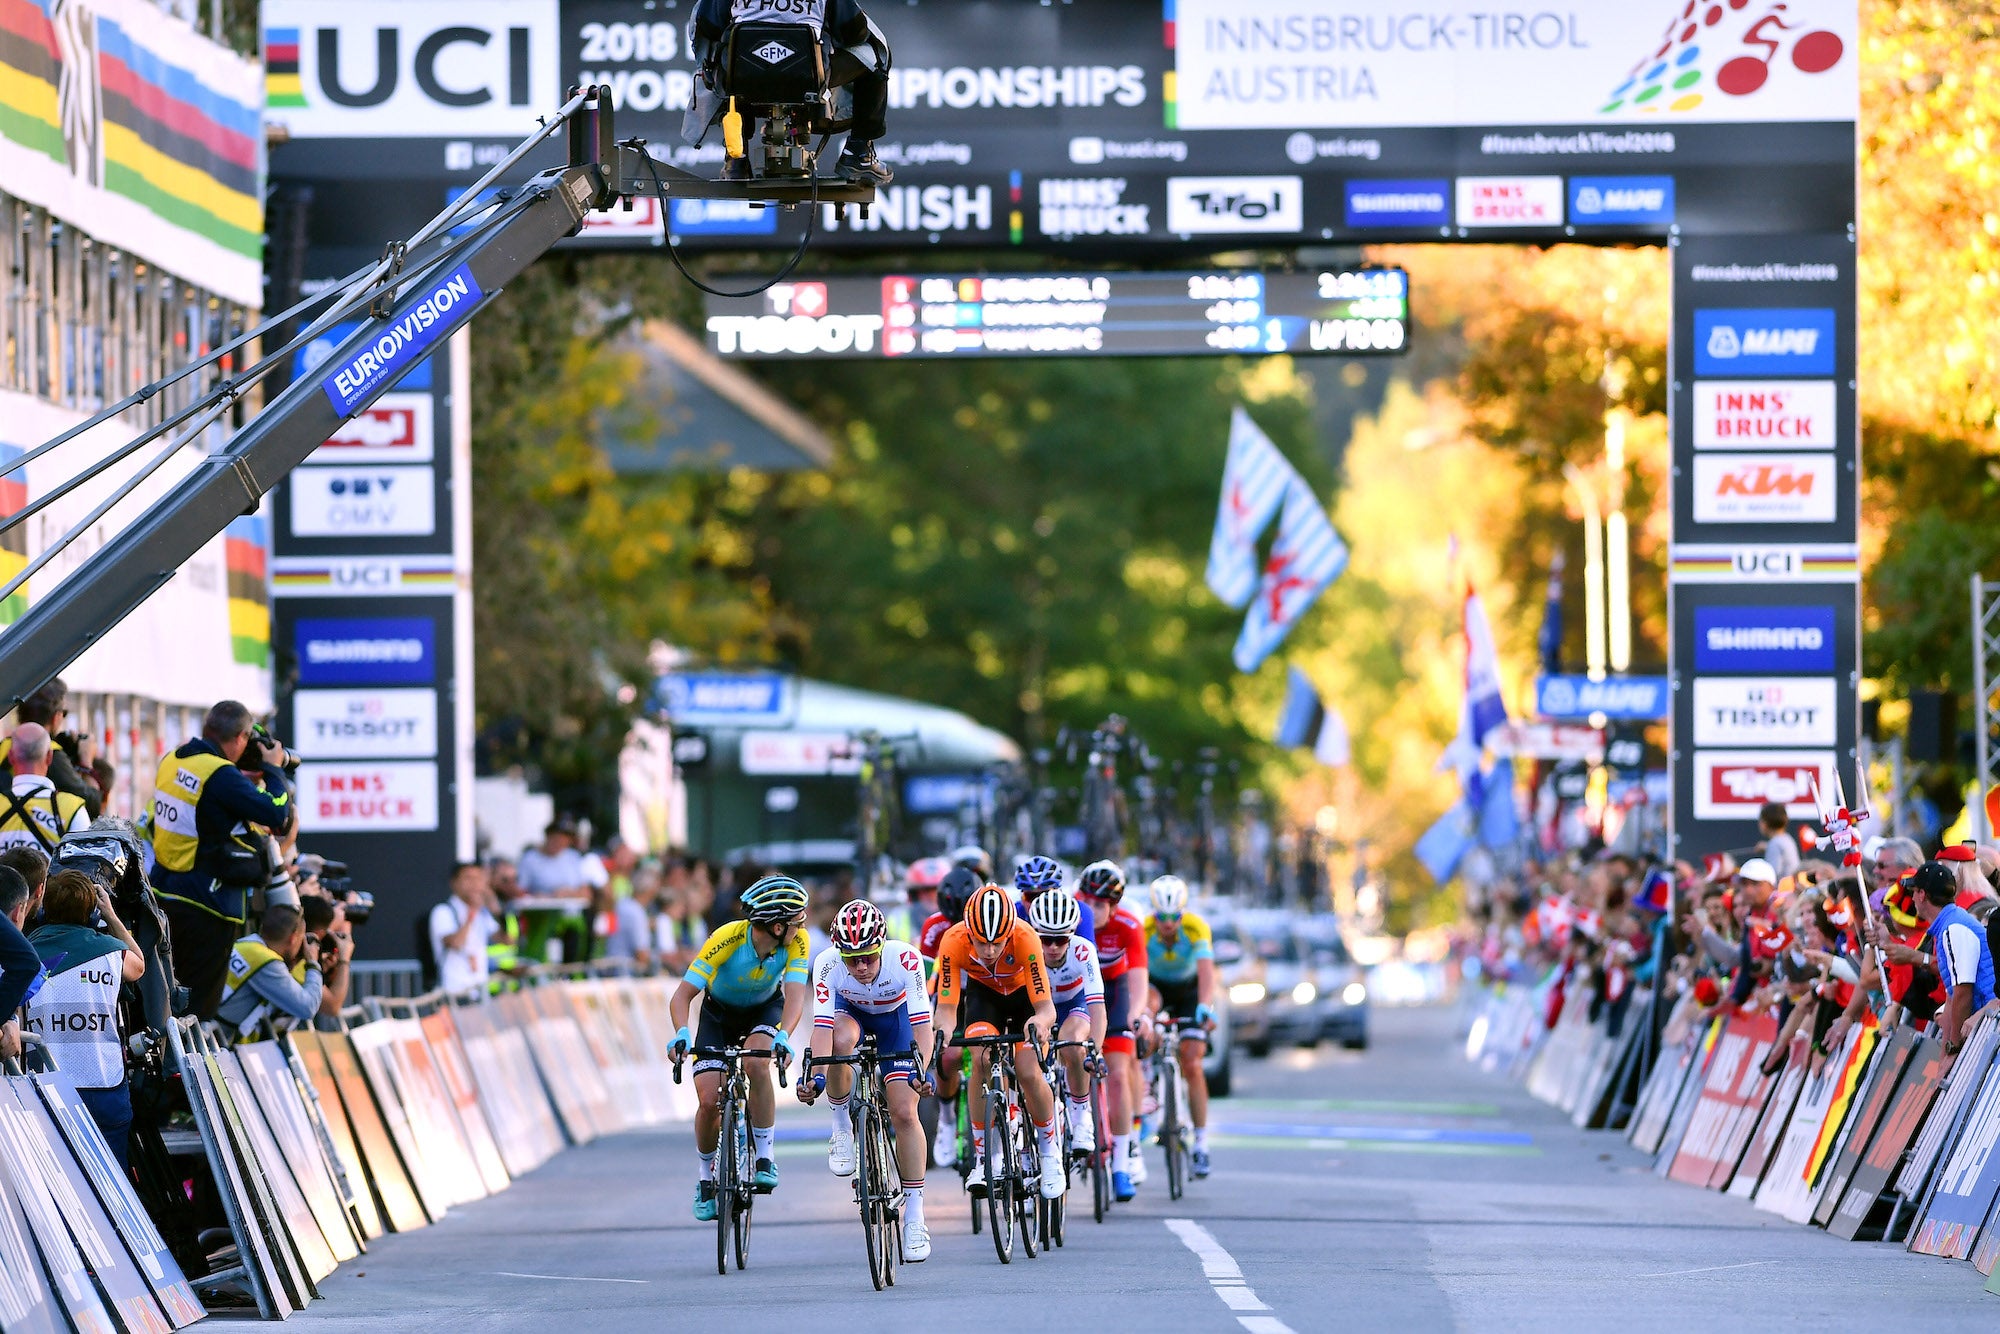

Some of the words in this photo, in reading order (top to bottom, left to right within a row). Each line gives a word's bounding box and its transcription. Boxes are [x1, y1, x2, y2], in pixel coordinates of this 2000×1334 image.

[760, 0, 817, 14] HOST
[579, 22, 678, 62] 2018
[1204, 12, 1588, 54] INNSBRUCK-TIROL
[316, 26, 531, 106] UCI
[760, 47, 787, 60] GFM
[578, 70, 697, 112] WOR
[887, 66, 1147, 107] PIONSHIPS
[1204, 66, 1379, 102] AUSTRIA
[1189, 191, 1282, 219] Tirol
[1040, 205, 1149, 235] BRUCK
[706, 314, 884, 354] TISSOT
[1742, 328, 1819, 355] MAPEI
[345, 381, 372, 406] OPERATED
[379, 367, 389, 379] EBU
[1716, 418, 1812, 437] BRUCK
[1715, 466, 1814, 496] KTM
[335, 565, 391, 586] UCI
[1737, 554, 1792, 574] UCI
[1706, 626, 1824, 651] SHIMANO
[310, 718, 419, 737] TISSOT
[1713, 707, 1817, 726] TISSOT
[178, 772, 198, 790] UCI
[156, 800, 178, 822] OTO
[704, 932, 745, 960] KAZAKHSTAN
[88, 970, 114, 986] UCI
[914, 970, 923, 992] HSBC
[942, 954, 951, 989] centric
[1029, 961, 1046, 995] centric
[51, 1013, 110, 1032] HOST
